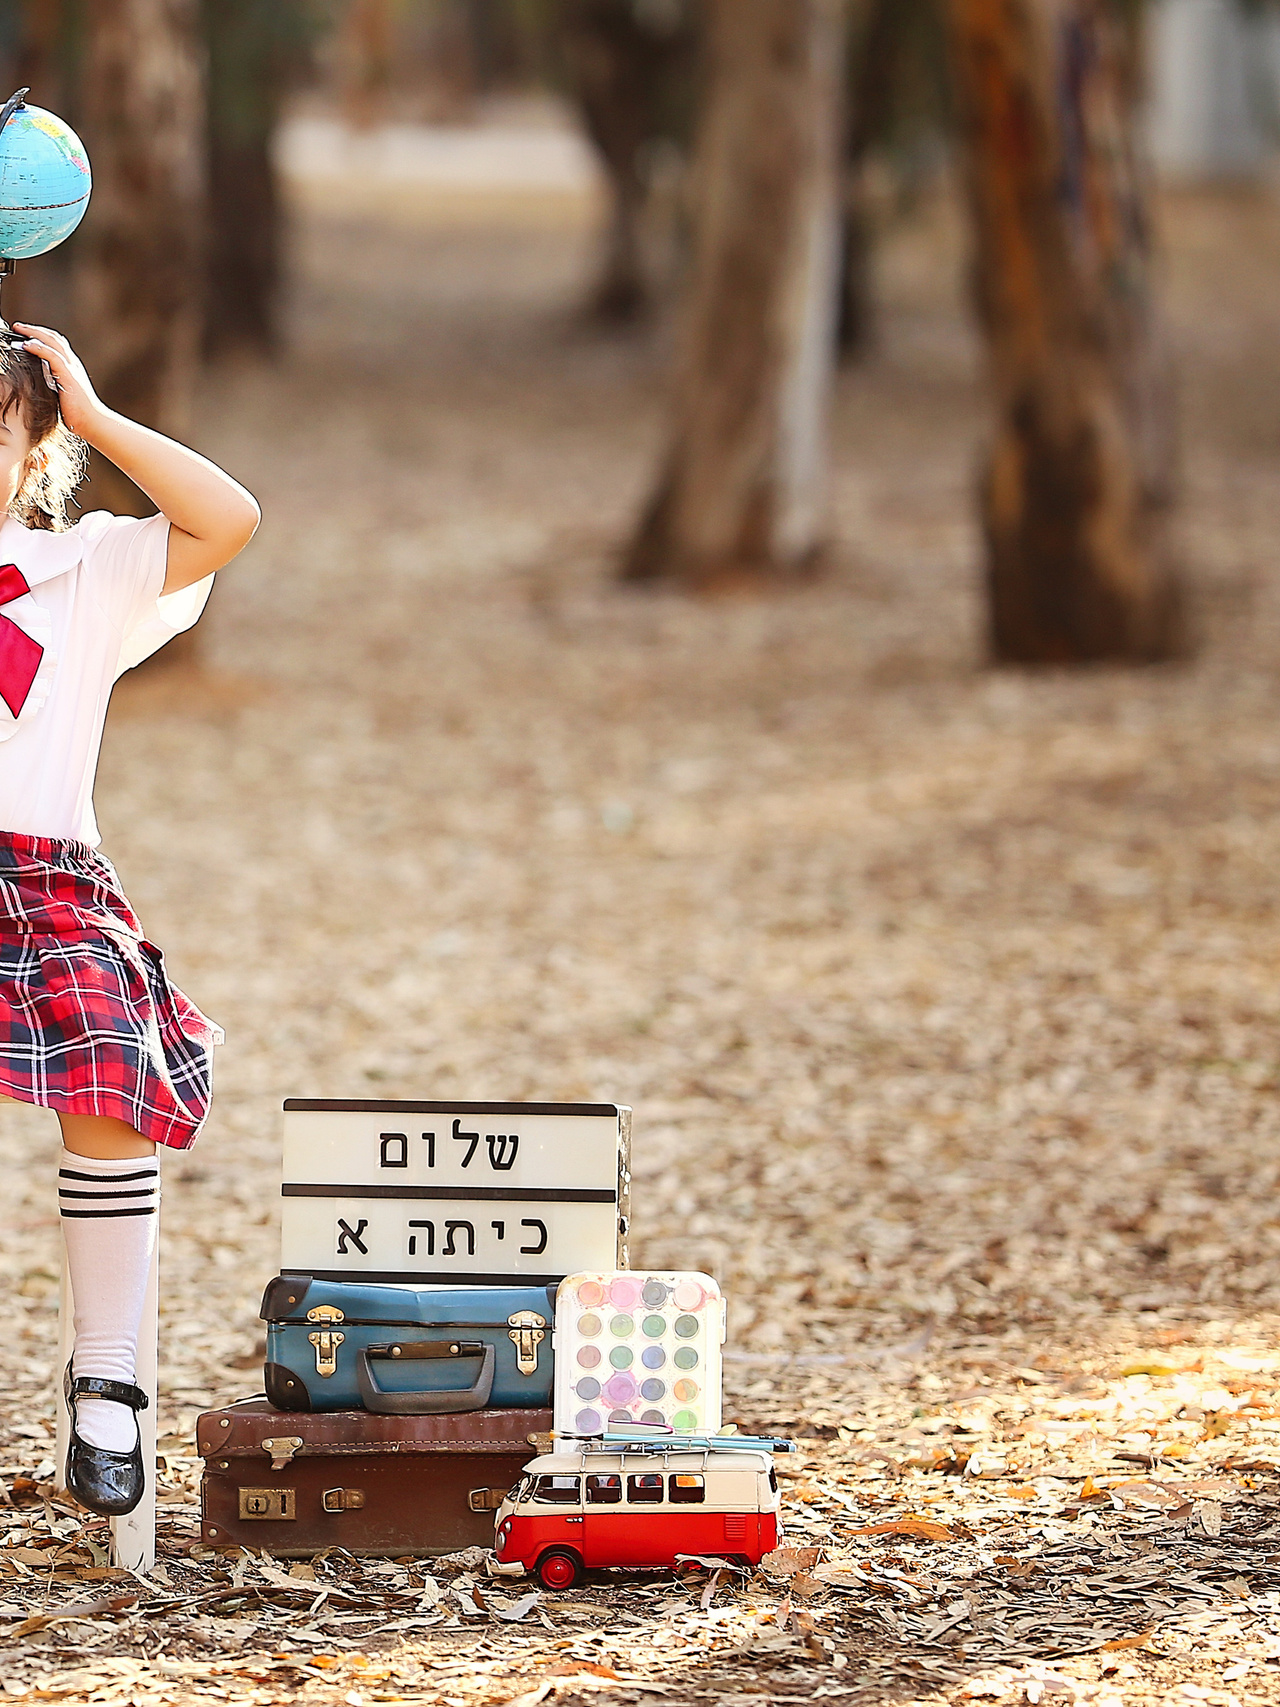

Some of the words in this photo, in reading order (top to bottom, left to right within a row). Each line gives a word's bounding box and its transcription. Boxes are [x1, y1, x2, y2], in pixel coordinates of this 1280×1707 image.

[379, 1119, 519, 1170] שלום
[337, 1218, 369, 1255] א
[408, 1218, 548, 1255] כיתה
